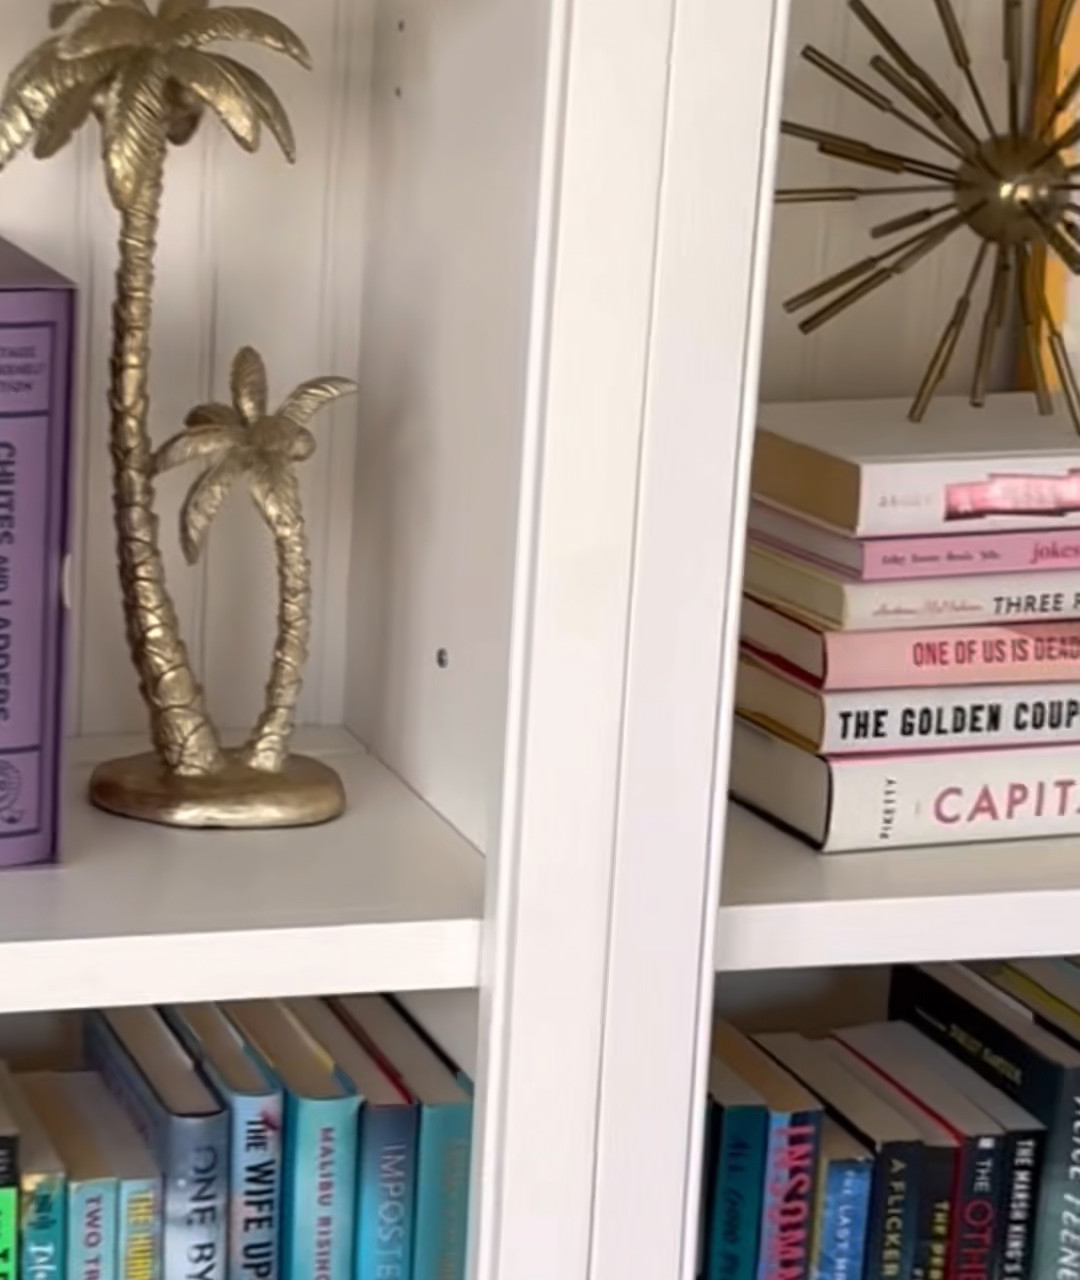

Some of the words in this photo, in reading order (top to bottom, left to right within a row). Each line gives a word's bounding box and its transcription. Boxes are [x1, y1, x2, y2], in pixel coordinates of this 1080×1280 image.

[992, 592, 1066, 615] THREE
[912, 640, 950, 669] ONE
[955, 638, 978, 666] OF
[983, 637, 1007, 664] US
[1011, 636, 1028, 663] IS
[837, 708, 888, 740] THE
[899, 703, 1002, 737] GOLDEN
[933, 779, 1080, 825] CAPIT
[243, 1118, 270, 1154] THE
[1013, 1138, 1034, 1167] THE
[187, 1143, 221, 1226] ONE
[315, 1125, 336, 1208] MALIBU
[973, 1157, 993, 1193] THE
[126, 1189, 155, 1224] THE
[240, 1157, 277, 1235] WIFE
[1009, 1169, 1031, 1219] MARSH
[84, 1193, 104, 1249] TWO
[834, 1203, 853, 1252] LAST
[881, 1180, 905, 1277] FLICKER
[931, 1200, 951, 1236] THE
[1004, 1222, 1027, 1273] KING'S
